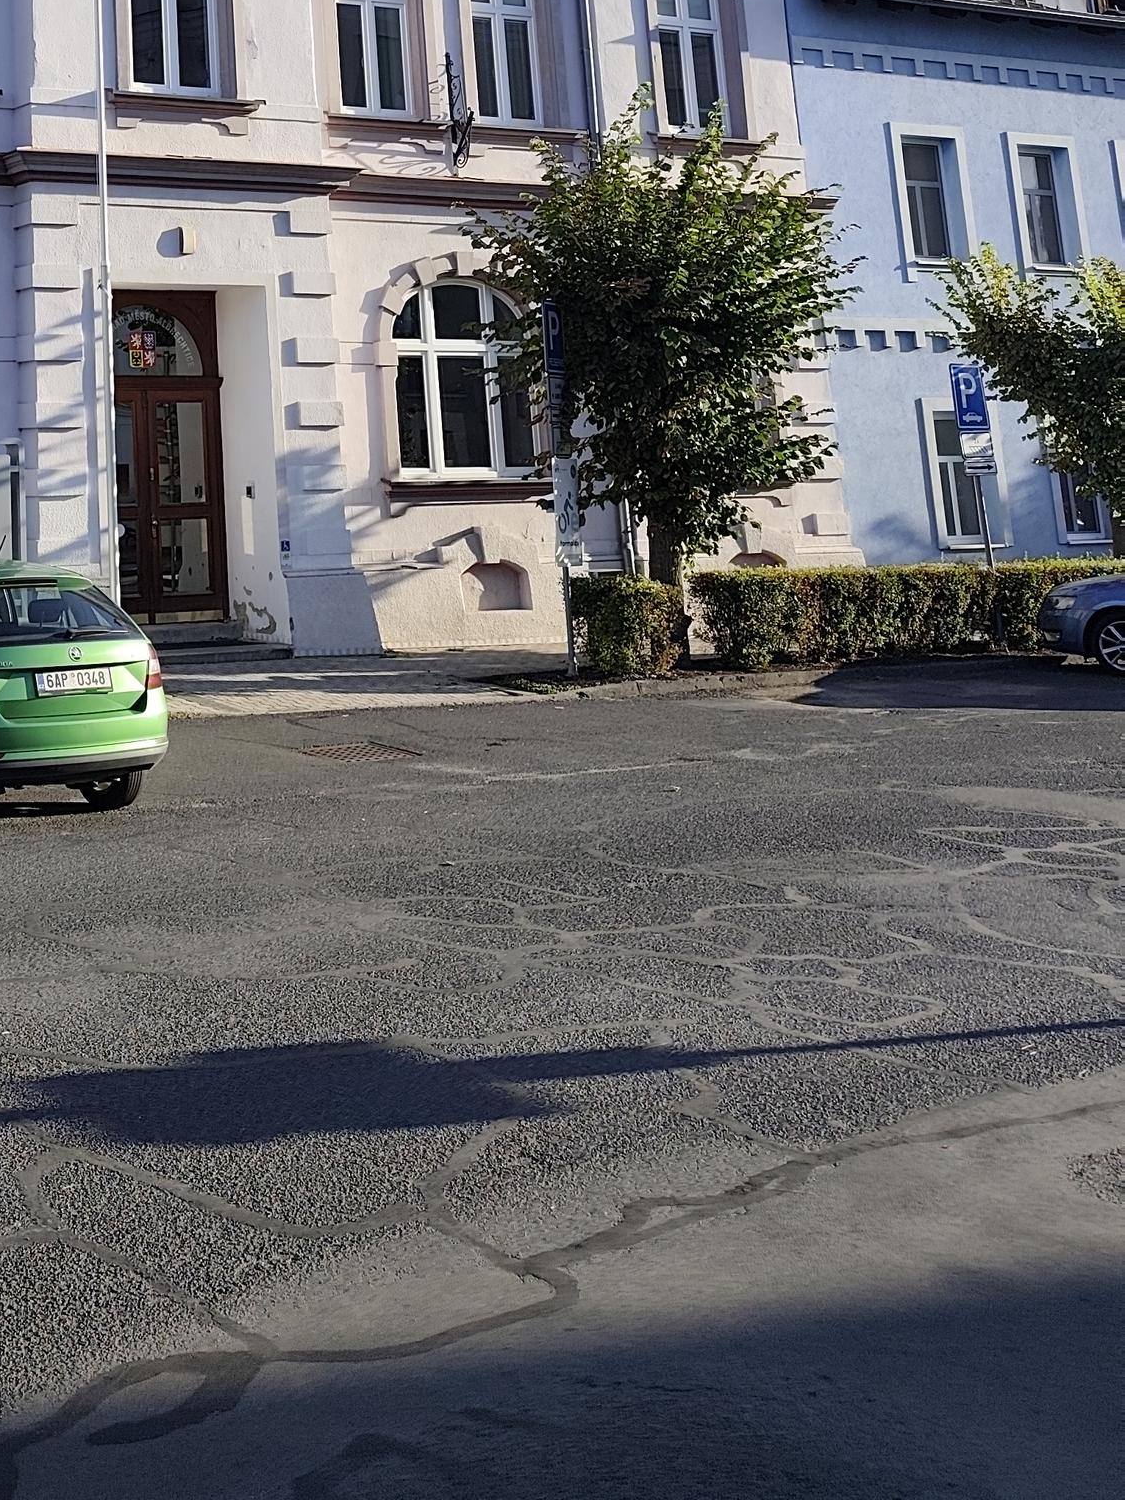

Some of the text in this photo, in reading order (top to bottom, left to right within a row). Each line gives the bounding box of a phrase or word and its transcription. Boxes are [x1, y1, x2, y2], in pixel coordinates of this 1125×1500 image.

[548, 311, 559, 350] P
[959, 373, 976, 408] P
[46, 671, 105, 688] 6AP 0348
